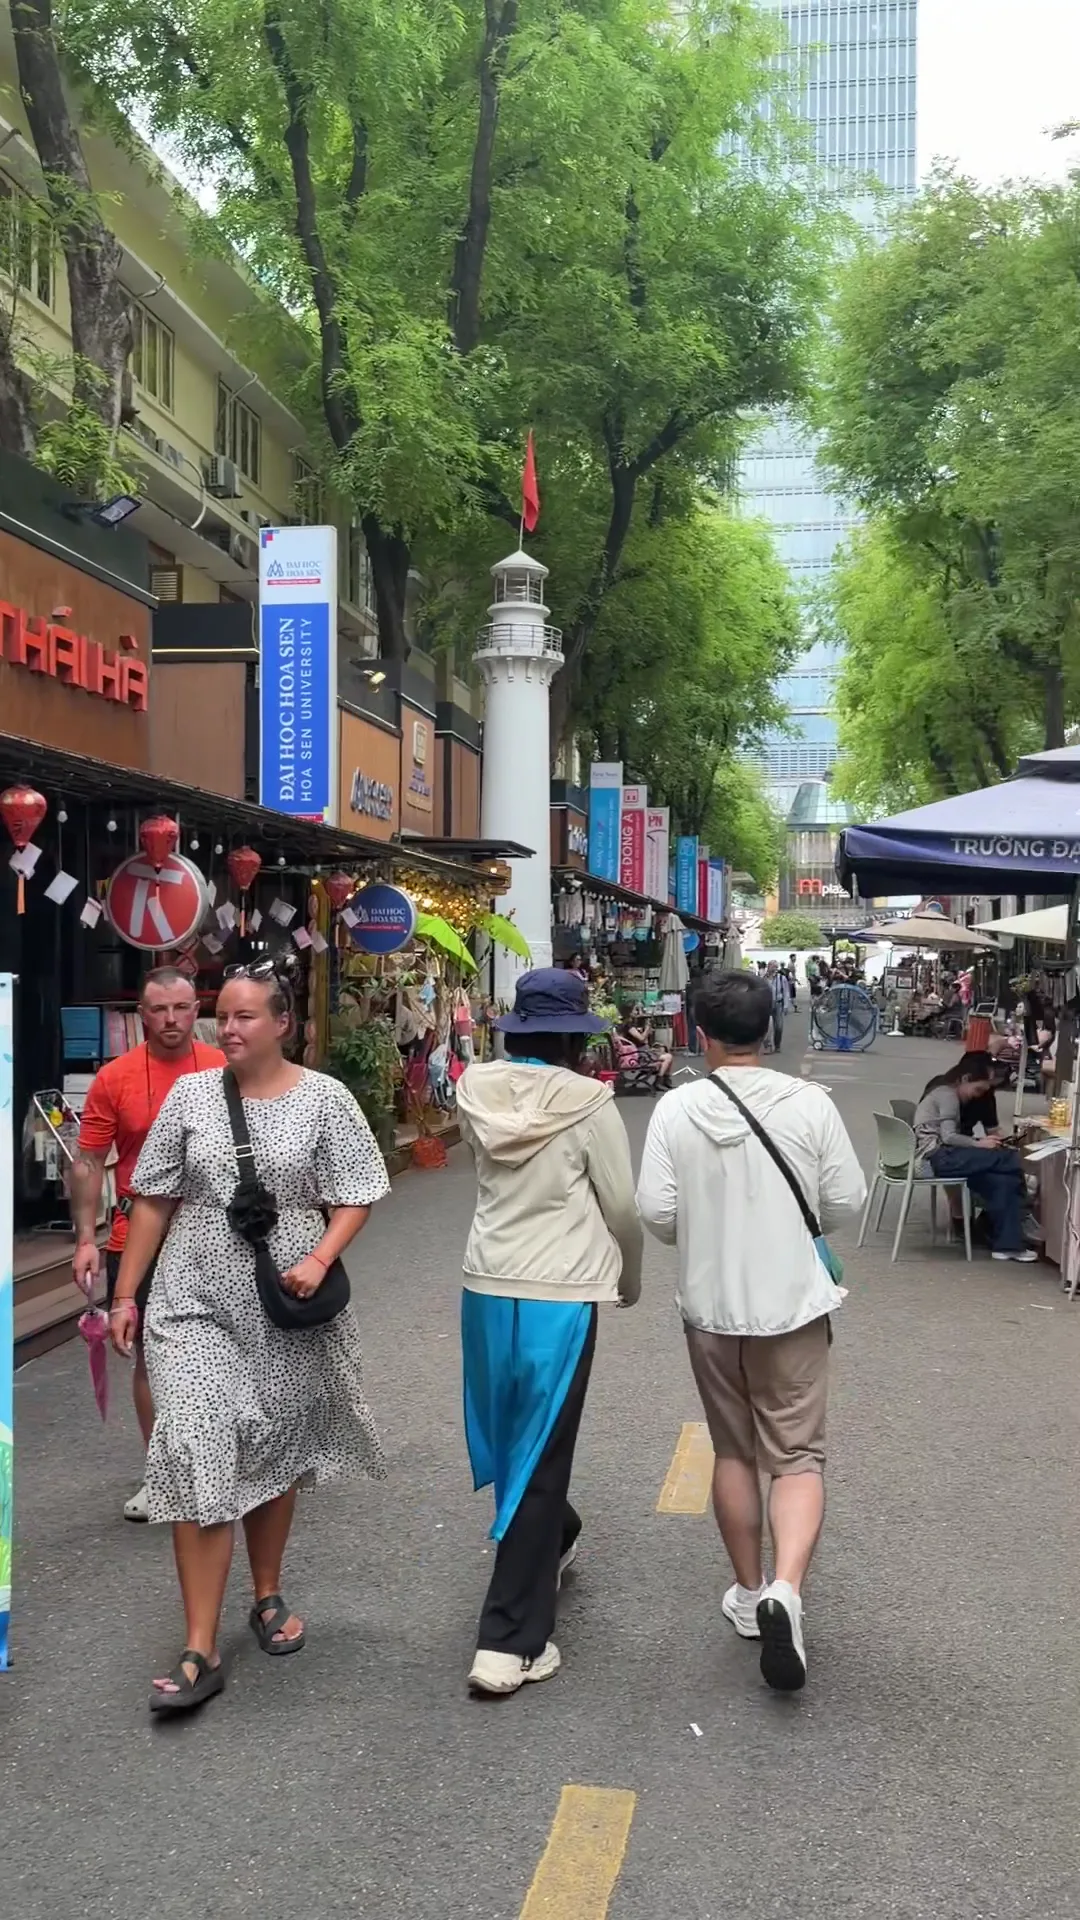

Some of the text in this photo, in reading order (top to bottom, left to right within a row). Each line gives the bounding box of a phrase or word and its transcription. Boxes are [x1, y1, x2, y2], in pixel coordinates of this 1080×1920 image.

[300, 617, 313, 720] UNIVERSITY
[279, 617, 296, 801] ĐẠI HỌC HOA SEN
[300, 728, 313, 760] SEN
[300, 768, 313, 801] HOA
[950, 832, 1046, 857] TRƯỜNG
